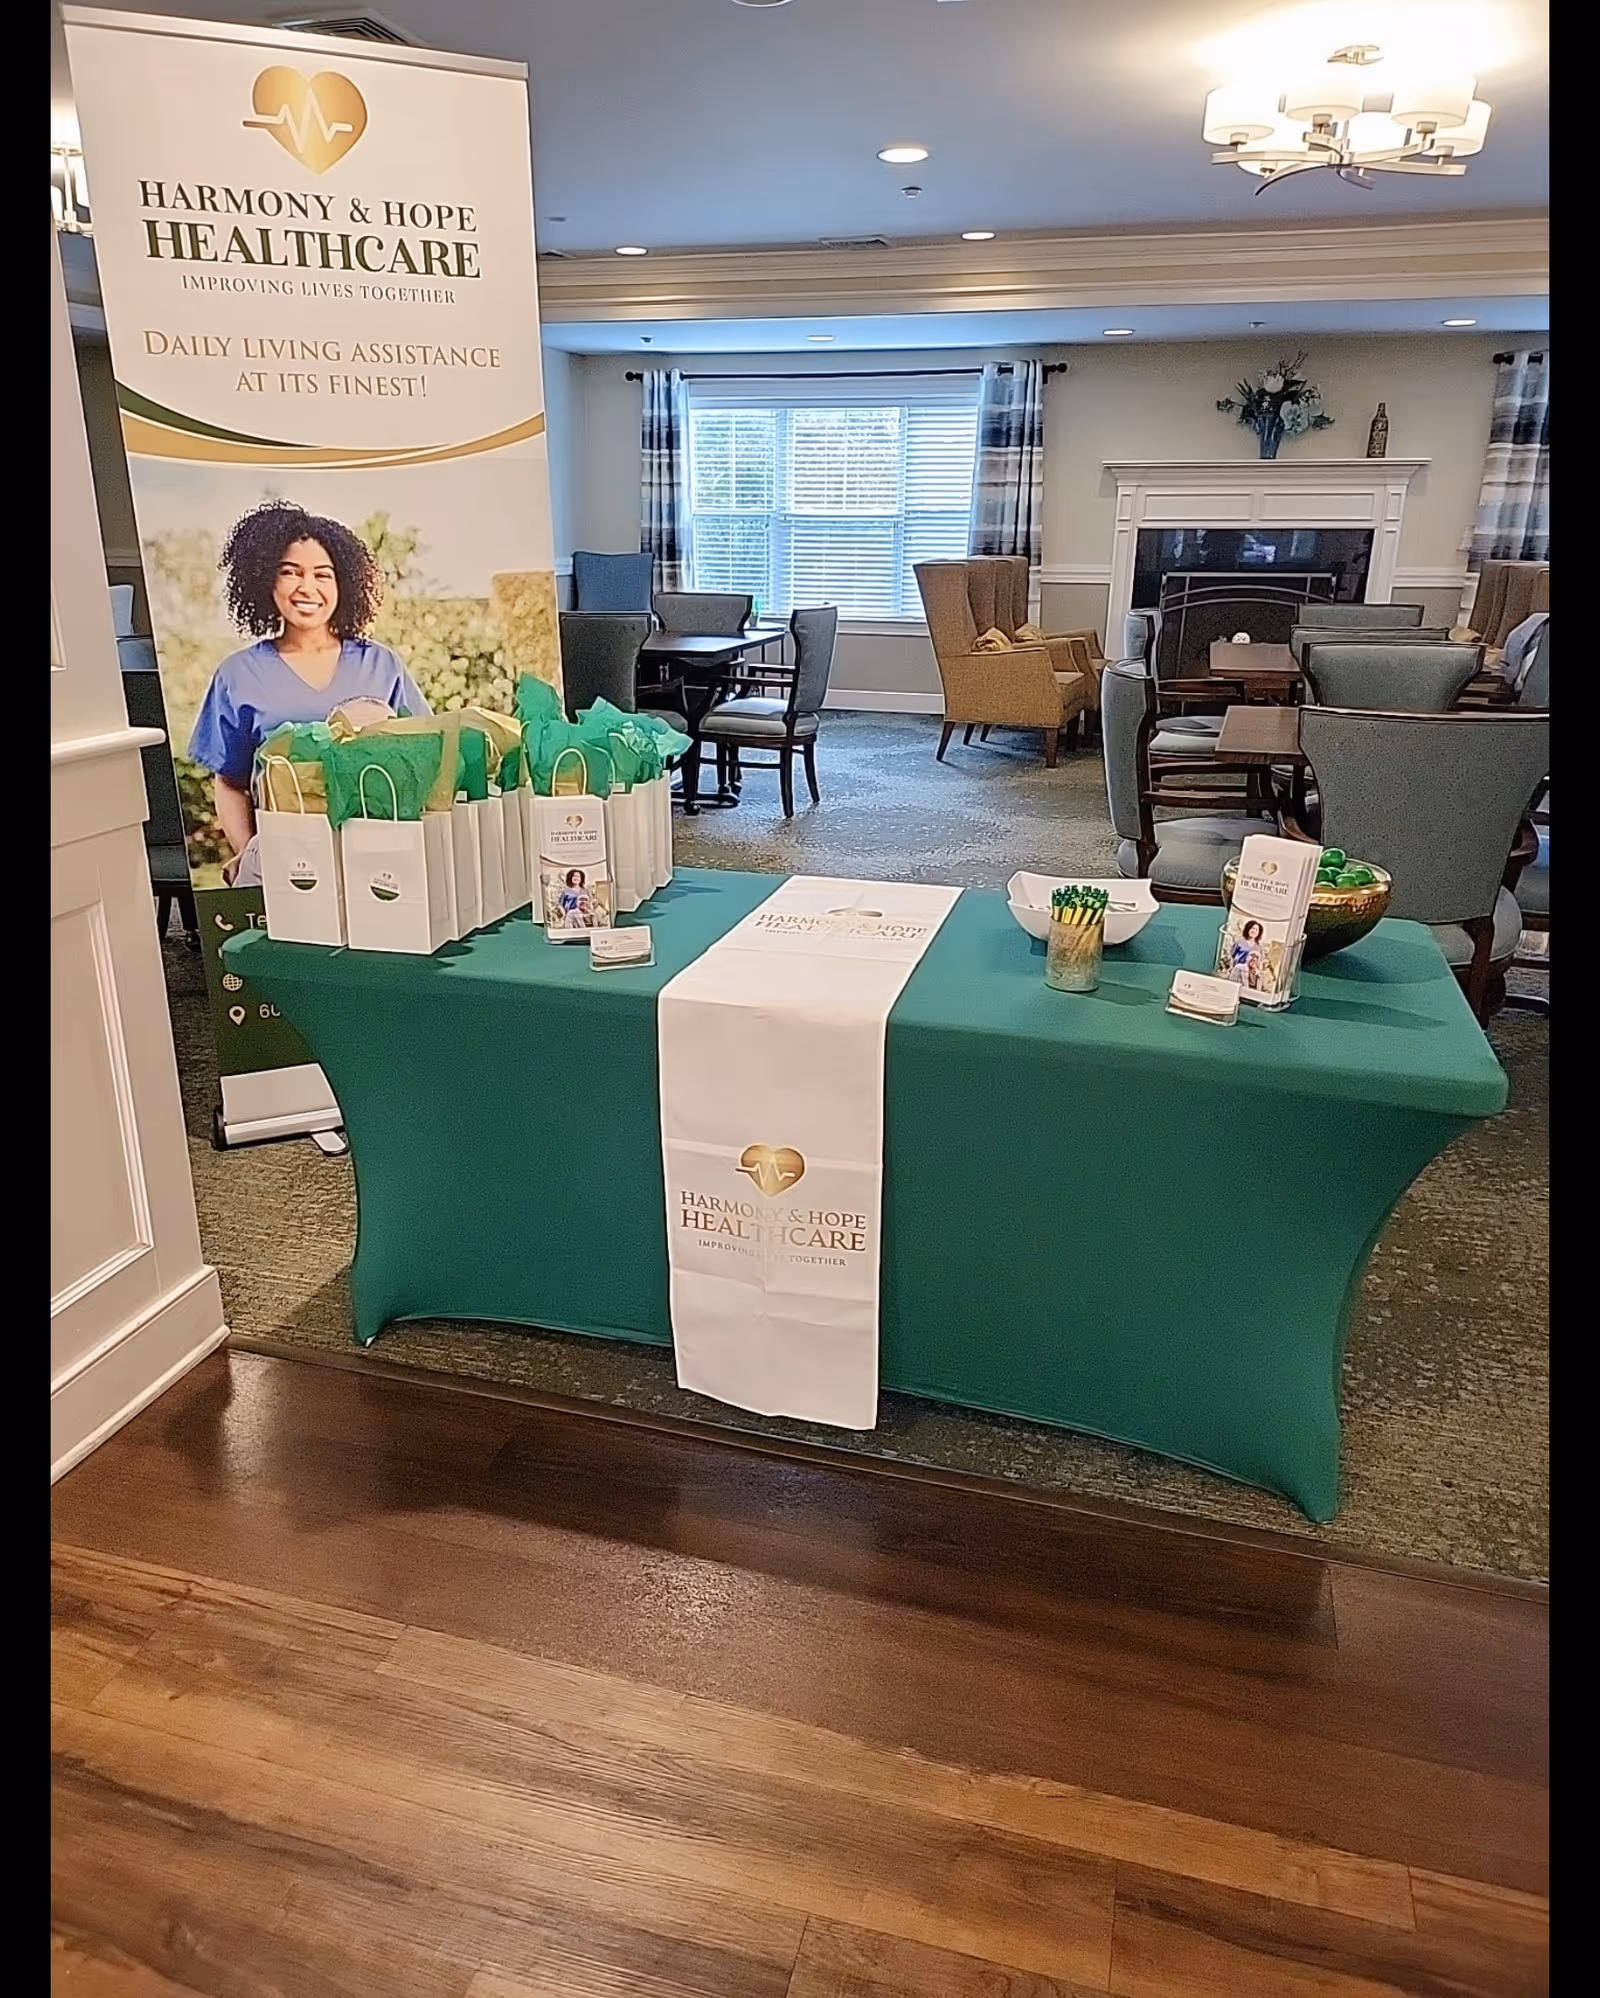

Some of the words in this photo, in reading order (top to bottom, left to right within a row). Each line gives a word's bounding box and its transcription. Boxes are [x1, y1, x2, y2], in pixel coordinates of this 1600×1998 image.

[138, 180, 336, 221] HARMONY
[350, 198, 373, 224] &
[382, 200, 477, 232] HOPE
[142, 219, 481, 279] HEALTHCARE
[182, 275, 294, 295] IMPROVING
[302, 282, 353, 299] LIVES
[360, 285, 455, 304] TOGETHER
[143, 330, 232, 357] DAILY
[243, 338, 341, 362] LIVING
[351, 343, 501, 368] ASSISTANCE
[236, 371, 268, 392] AT
[278, 373, 319, 394] ITS
[329, 374, 428, 398] FINEST!
[681, 1209, 866, 1252] HEALTHCARE
[788, 1208, 804, 1224] &
[808, 1210, 867, 1230] HOPE
[789, 1254, 847, 1267] TOGETHER
